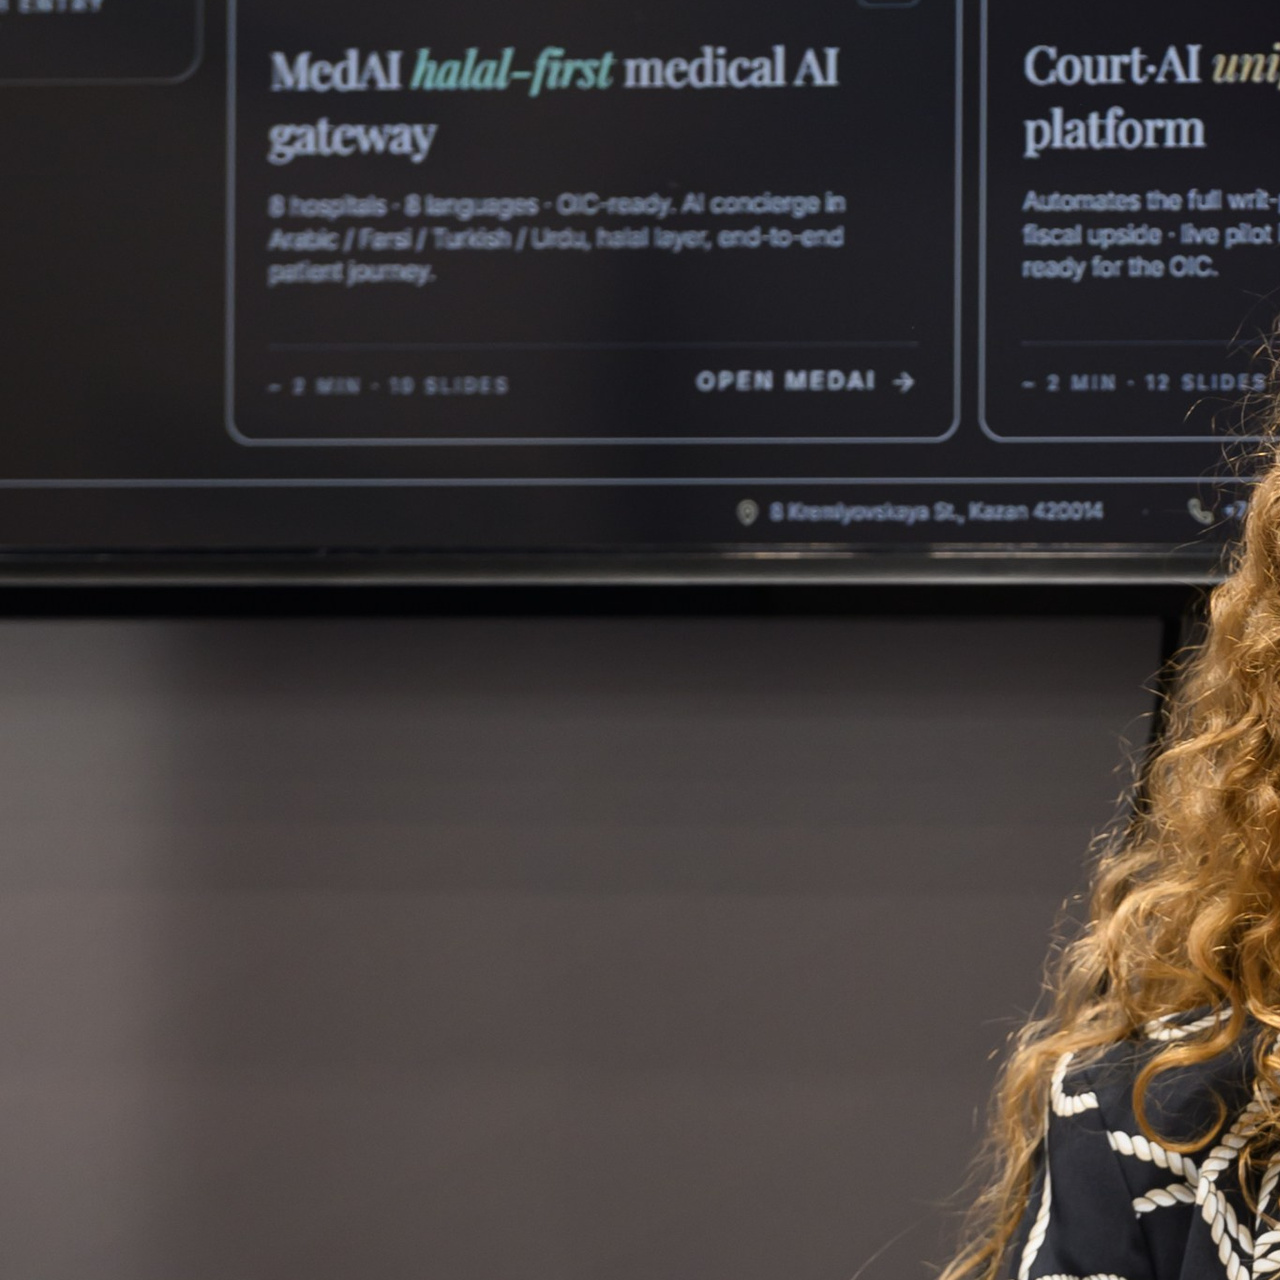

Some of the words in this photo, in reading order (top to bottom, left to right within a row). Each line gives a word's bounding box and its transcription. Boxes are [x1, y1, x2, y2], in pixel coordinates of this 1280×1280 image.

[271, 48, 402, 92] MedAI
[410, 47, 615, 96] halal-first
[624, 44, 787, 88] medical
[793, 47, 840, 86] AI
[268, 117, 438, 164] gateway
[1024, 105, 1206, 158] platform
[695, 370, 774, 391] OPEN
[784, 369, 875, 390] MEDAI
